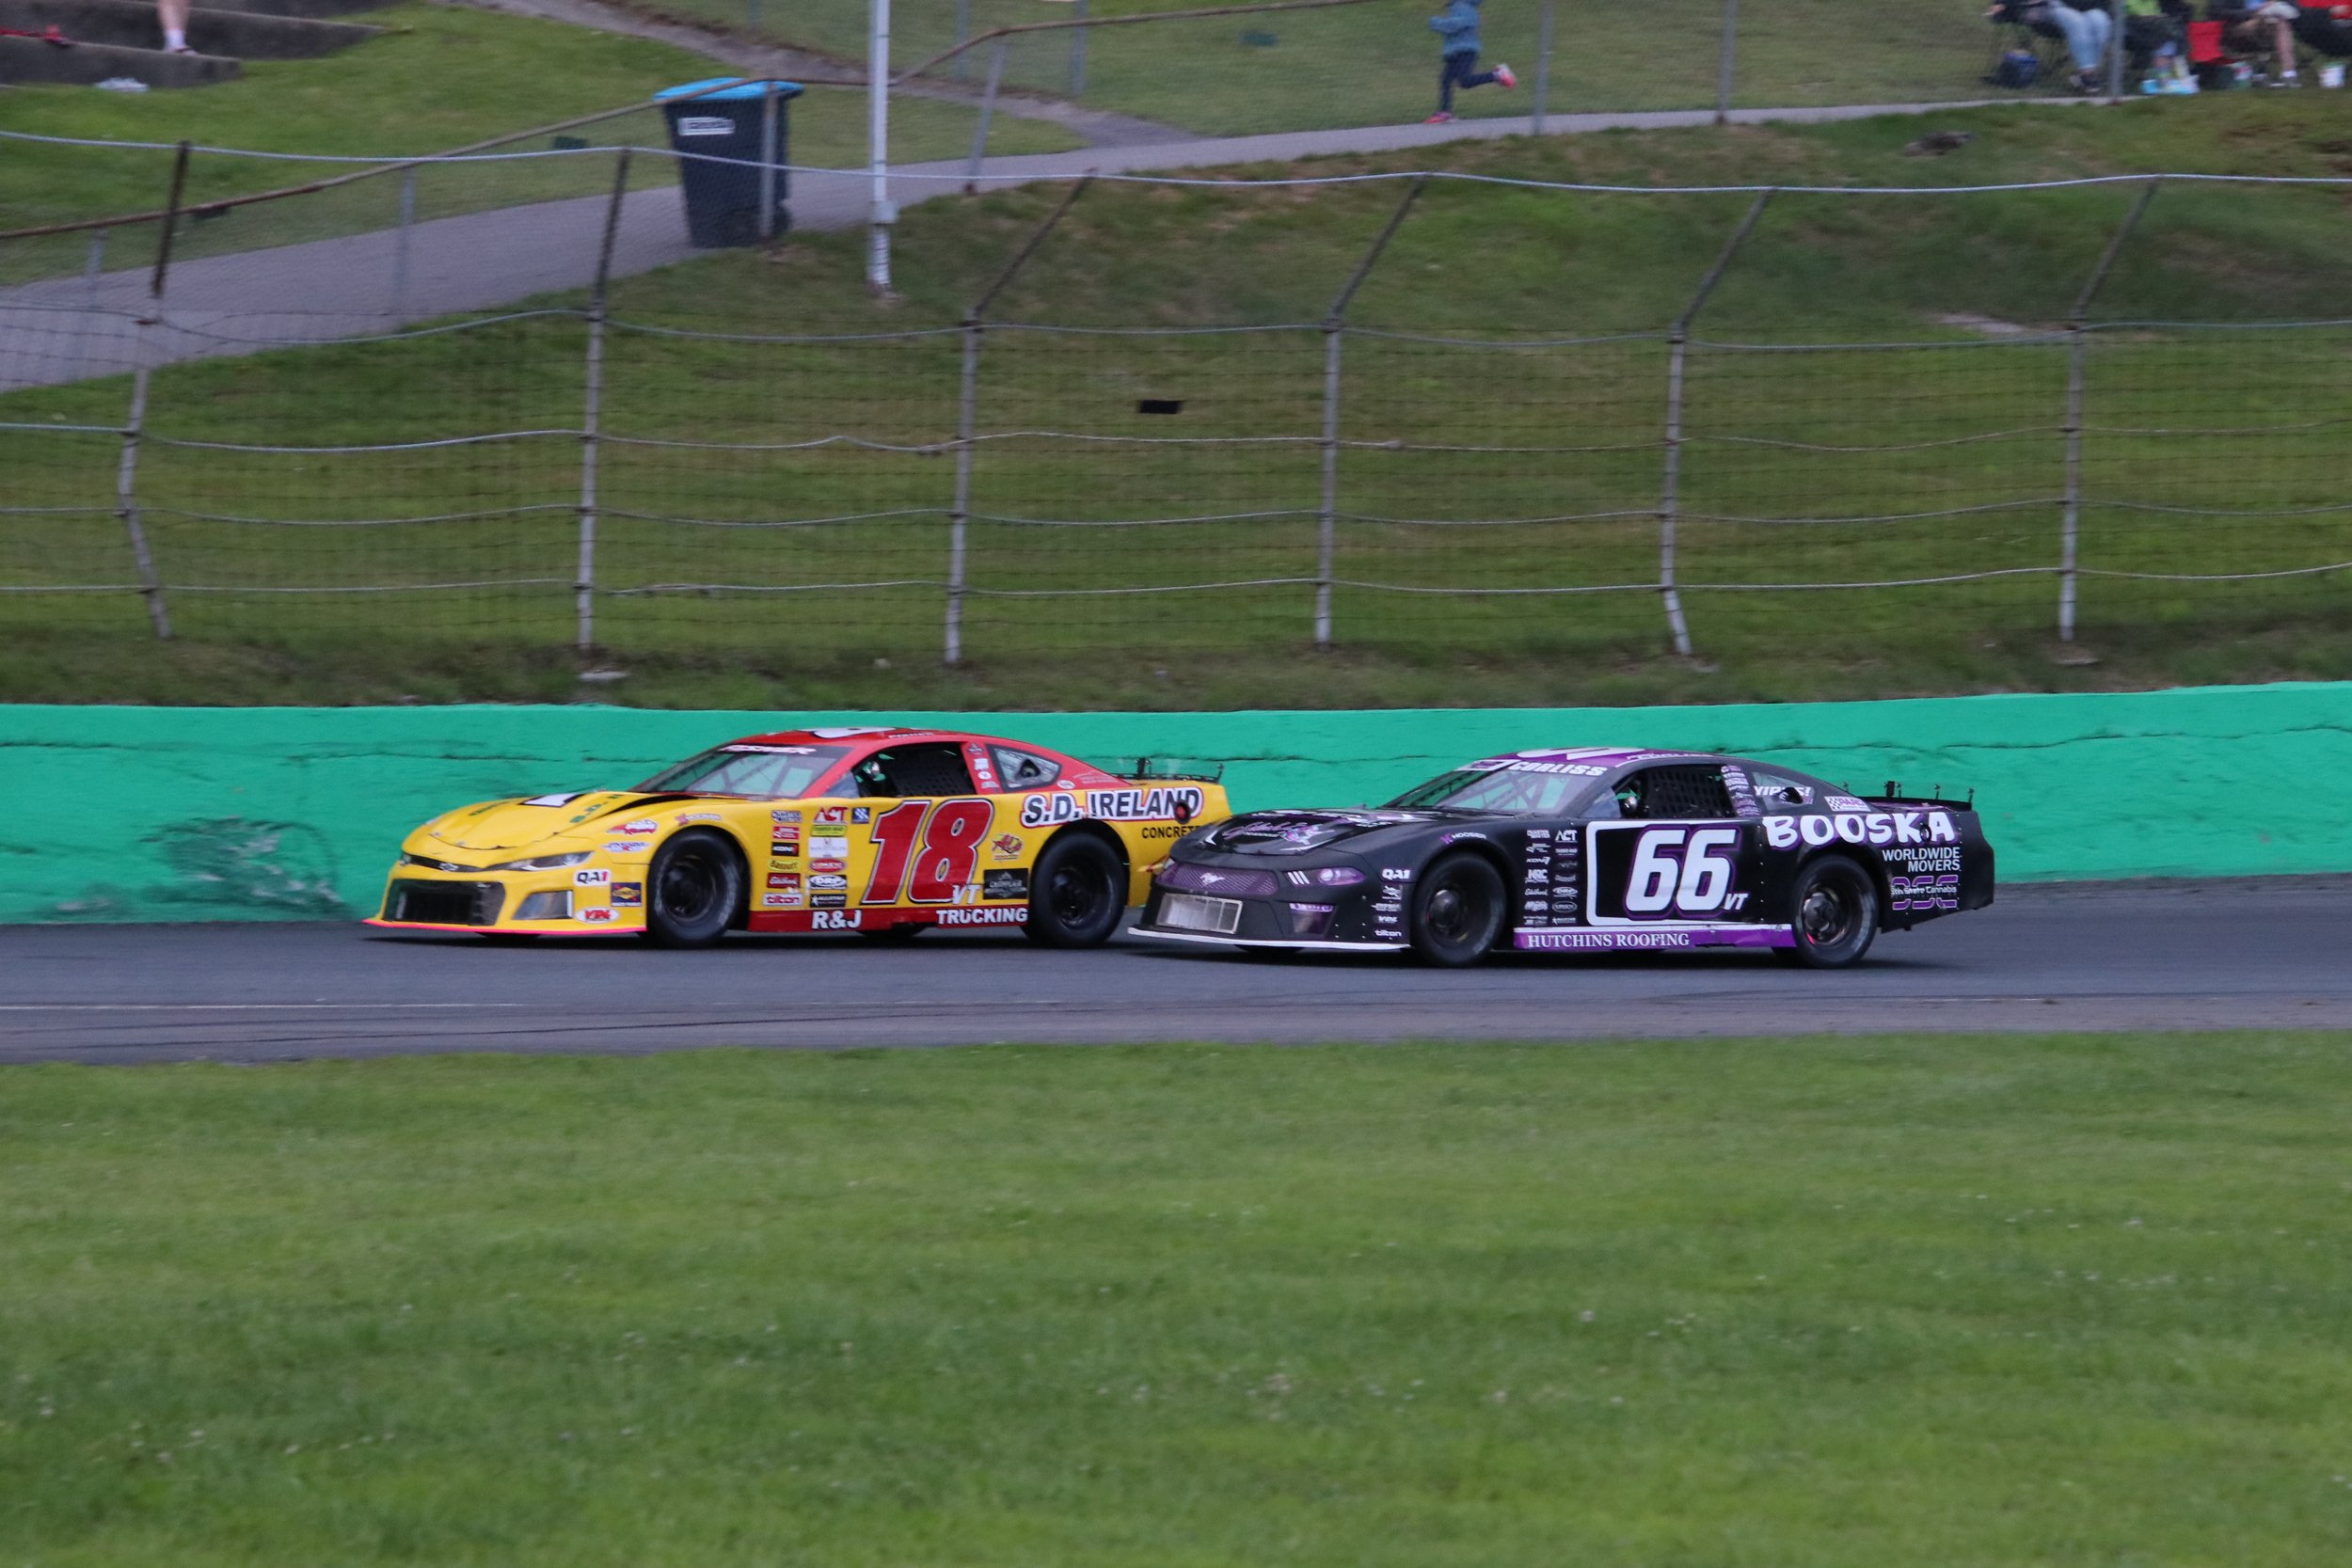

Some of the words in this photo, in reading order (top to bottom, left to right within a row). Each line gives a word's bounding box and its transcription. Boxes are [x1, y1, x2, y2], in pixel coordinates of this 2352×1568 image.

[1508, 760, 1608, 777] CORLISS
[1023, 793, 1082, 827] S.D.
[1087, 787, 1203, 820] IRELAND
[1141, 825, 1200, 839] CONCRET
[1555, 830, 1578, 841] ACT
[1762, 811, 1956, 847] BOOSKA
[860, 798, 994, 906] 18
[1882, 847, 1961, 862] WORLDWIDE
[1382, 868, 1410, 880] QA1
[1625, 828, 1738, 912] 66
[1907, 859, 1961, 873] MOVERS
[577, 871, 608, 884] QA1
[952, 884, 982, 905] VT
[1926, 884, 1957, 894] Cannabis
[1724, 893, 1749, 911] VT
[811, 910, 863, 929] R&J
[935, 908, 1028, 925] TRUCKING
[1527, 933, 1613, 948] HUTCHINS
[1615, 932, 1690, 947] ROOFING
